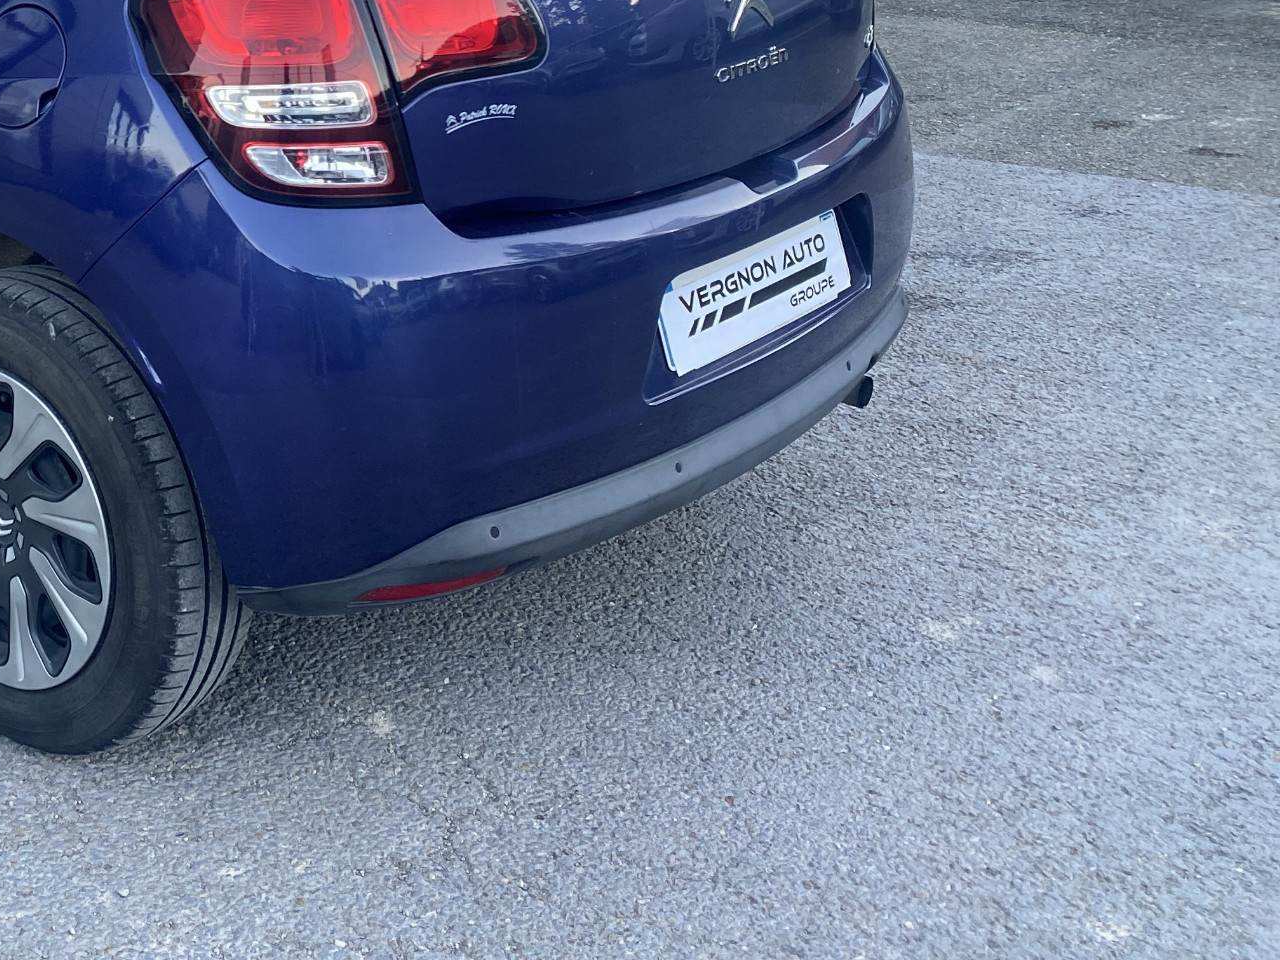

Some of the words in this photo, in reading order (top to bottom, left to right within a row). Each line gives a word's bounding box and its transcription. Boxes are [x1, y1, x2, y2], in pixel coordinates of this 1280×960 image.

[678, 255, 777, 314] VERGNON
[783, 233, 826, 271] AUTO
[790, 275, 835, 307] GROUPE
